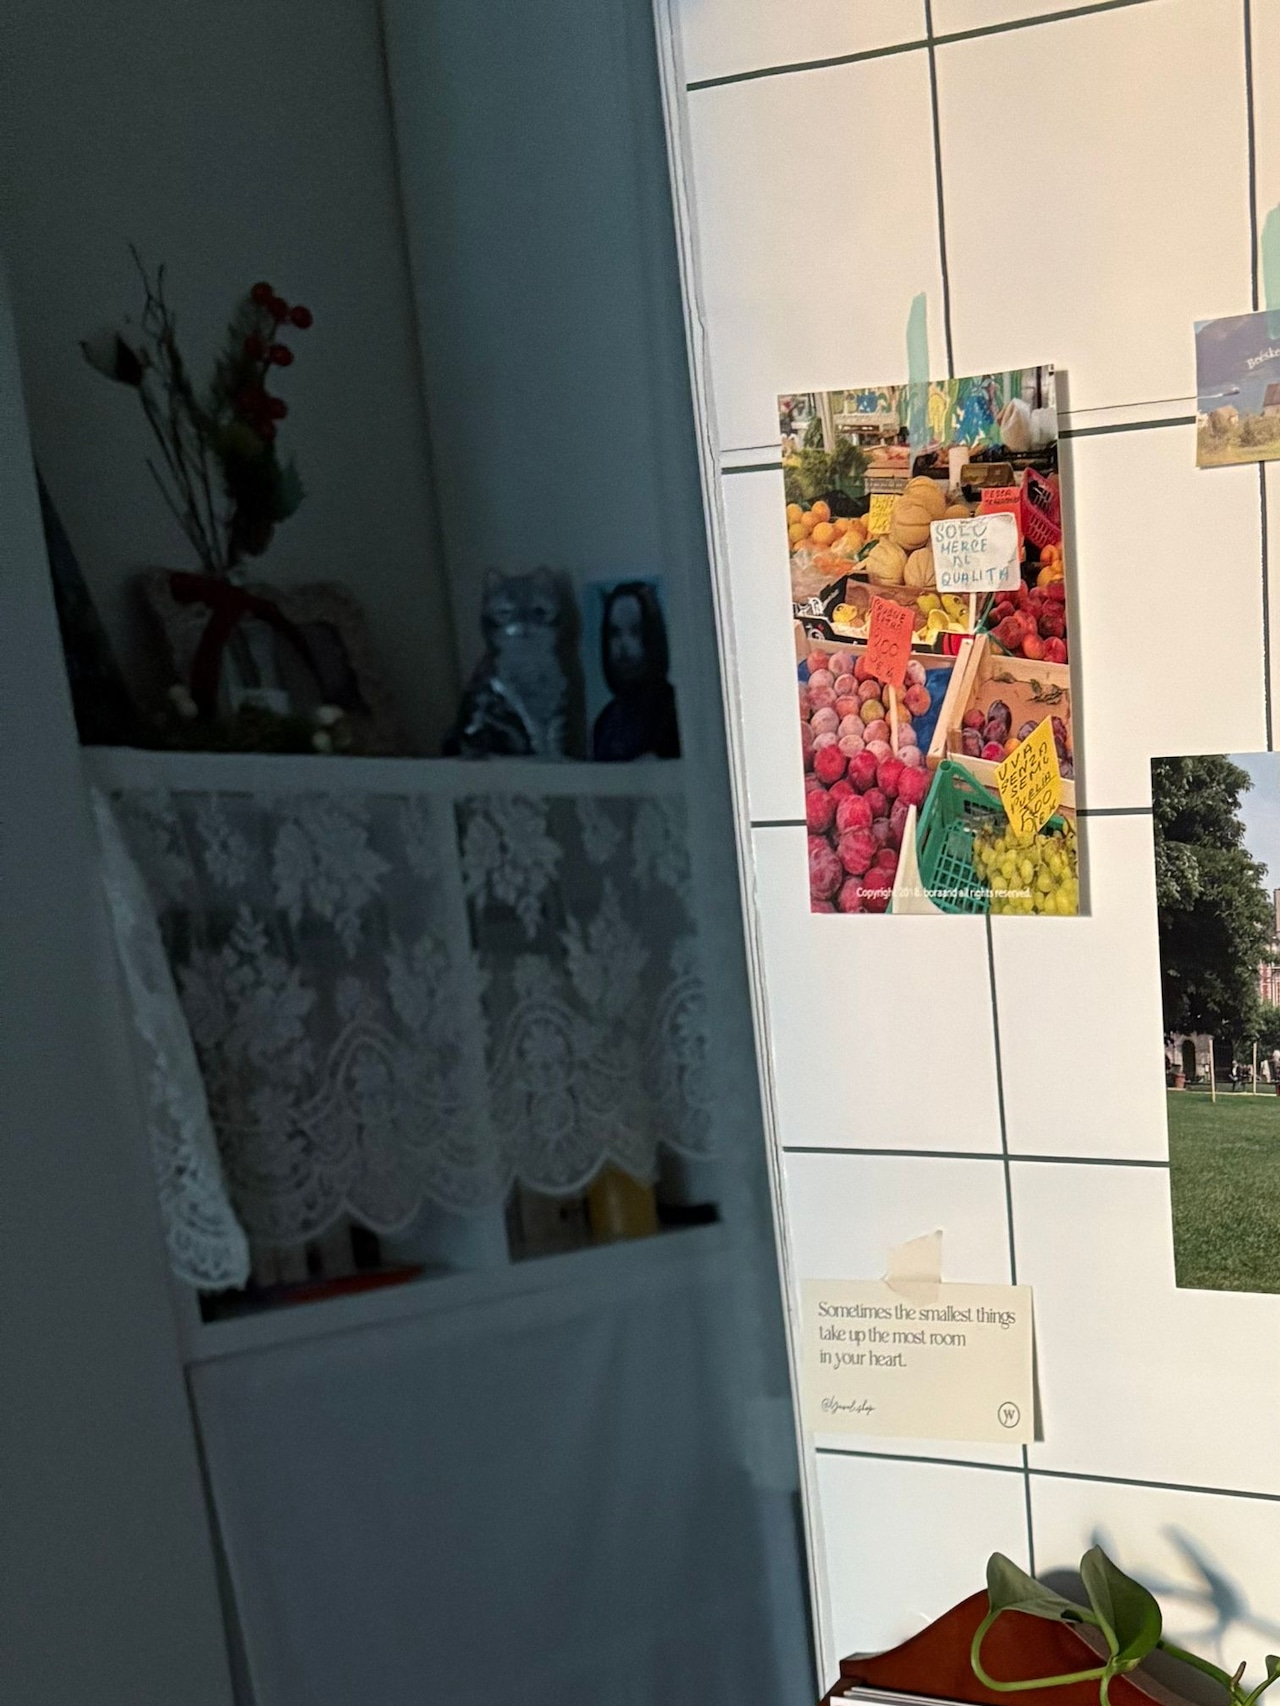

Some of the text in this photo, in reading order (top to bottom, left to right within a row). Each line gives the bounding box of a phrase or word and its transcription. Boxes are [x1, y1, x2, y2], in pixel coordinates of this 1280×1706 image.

[970, 887, 993, 900] rights
[818, 1301, 1016, 1330] Sometimes the smallest things
[819, 1325, 966, 1347] take up the most room
[819, 1350, 832, 1364] in
[834, 1353, 866, 1370] your
